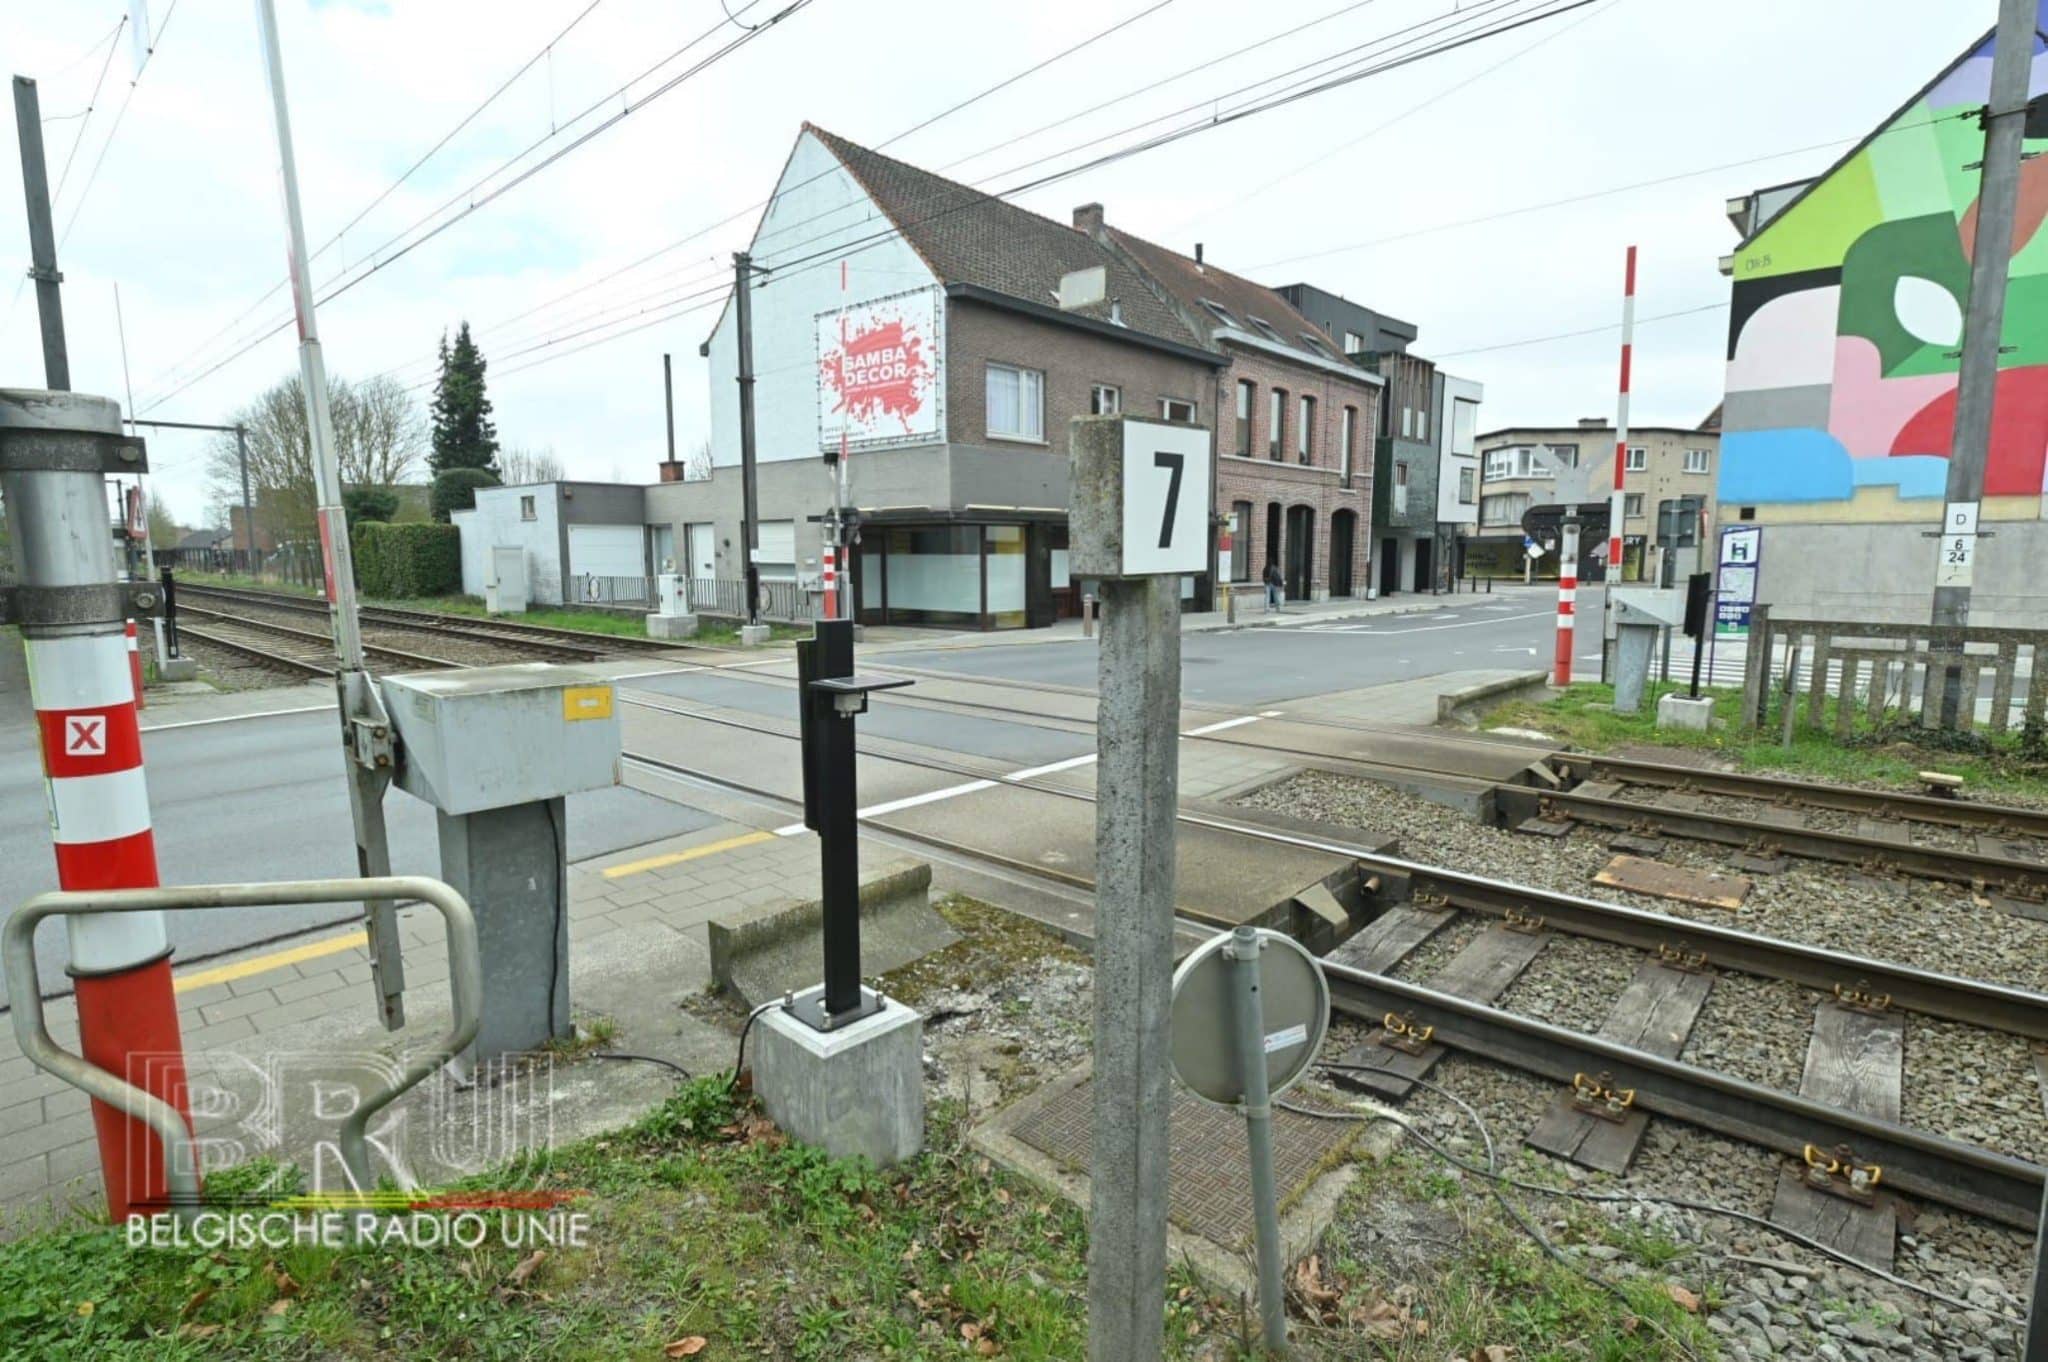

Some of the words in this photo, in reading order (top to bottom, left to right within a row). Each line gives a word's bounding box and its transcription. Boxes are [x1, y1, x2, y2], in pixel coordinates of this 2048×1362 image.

[844, 346, 907, 371] SAMBA
[845, 363, 907, 387] DECOR
[1154, 451, 1184, 549] 7
[1956, 513, 1967, 526] D
[1954, 538, 1964, 551] 6
[1948, 551, 1966, 563] 24
